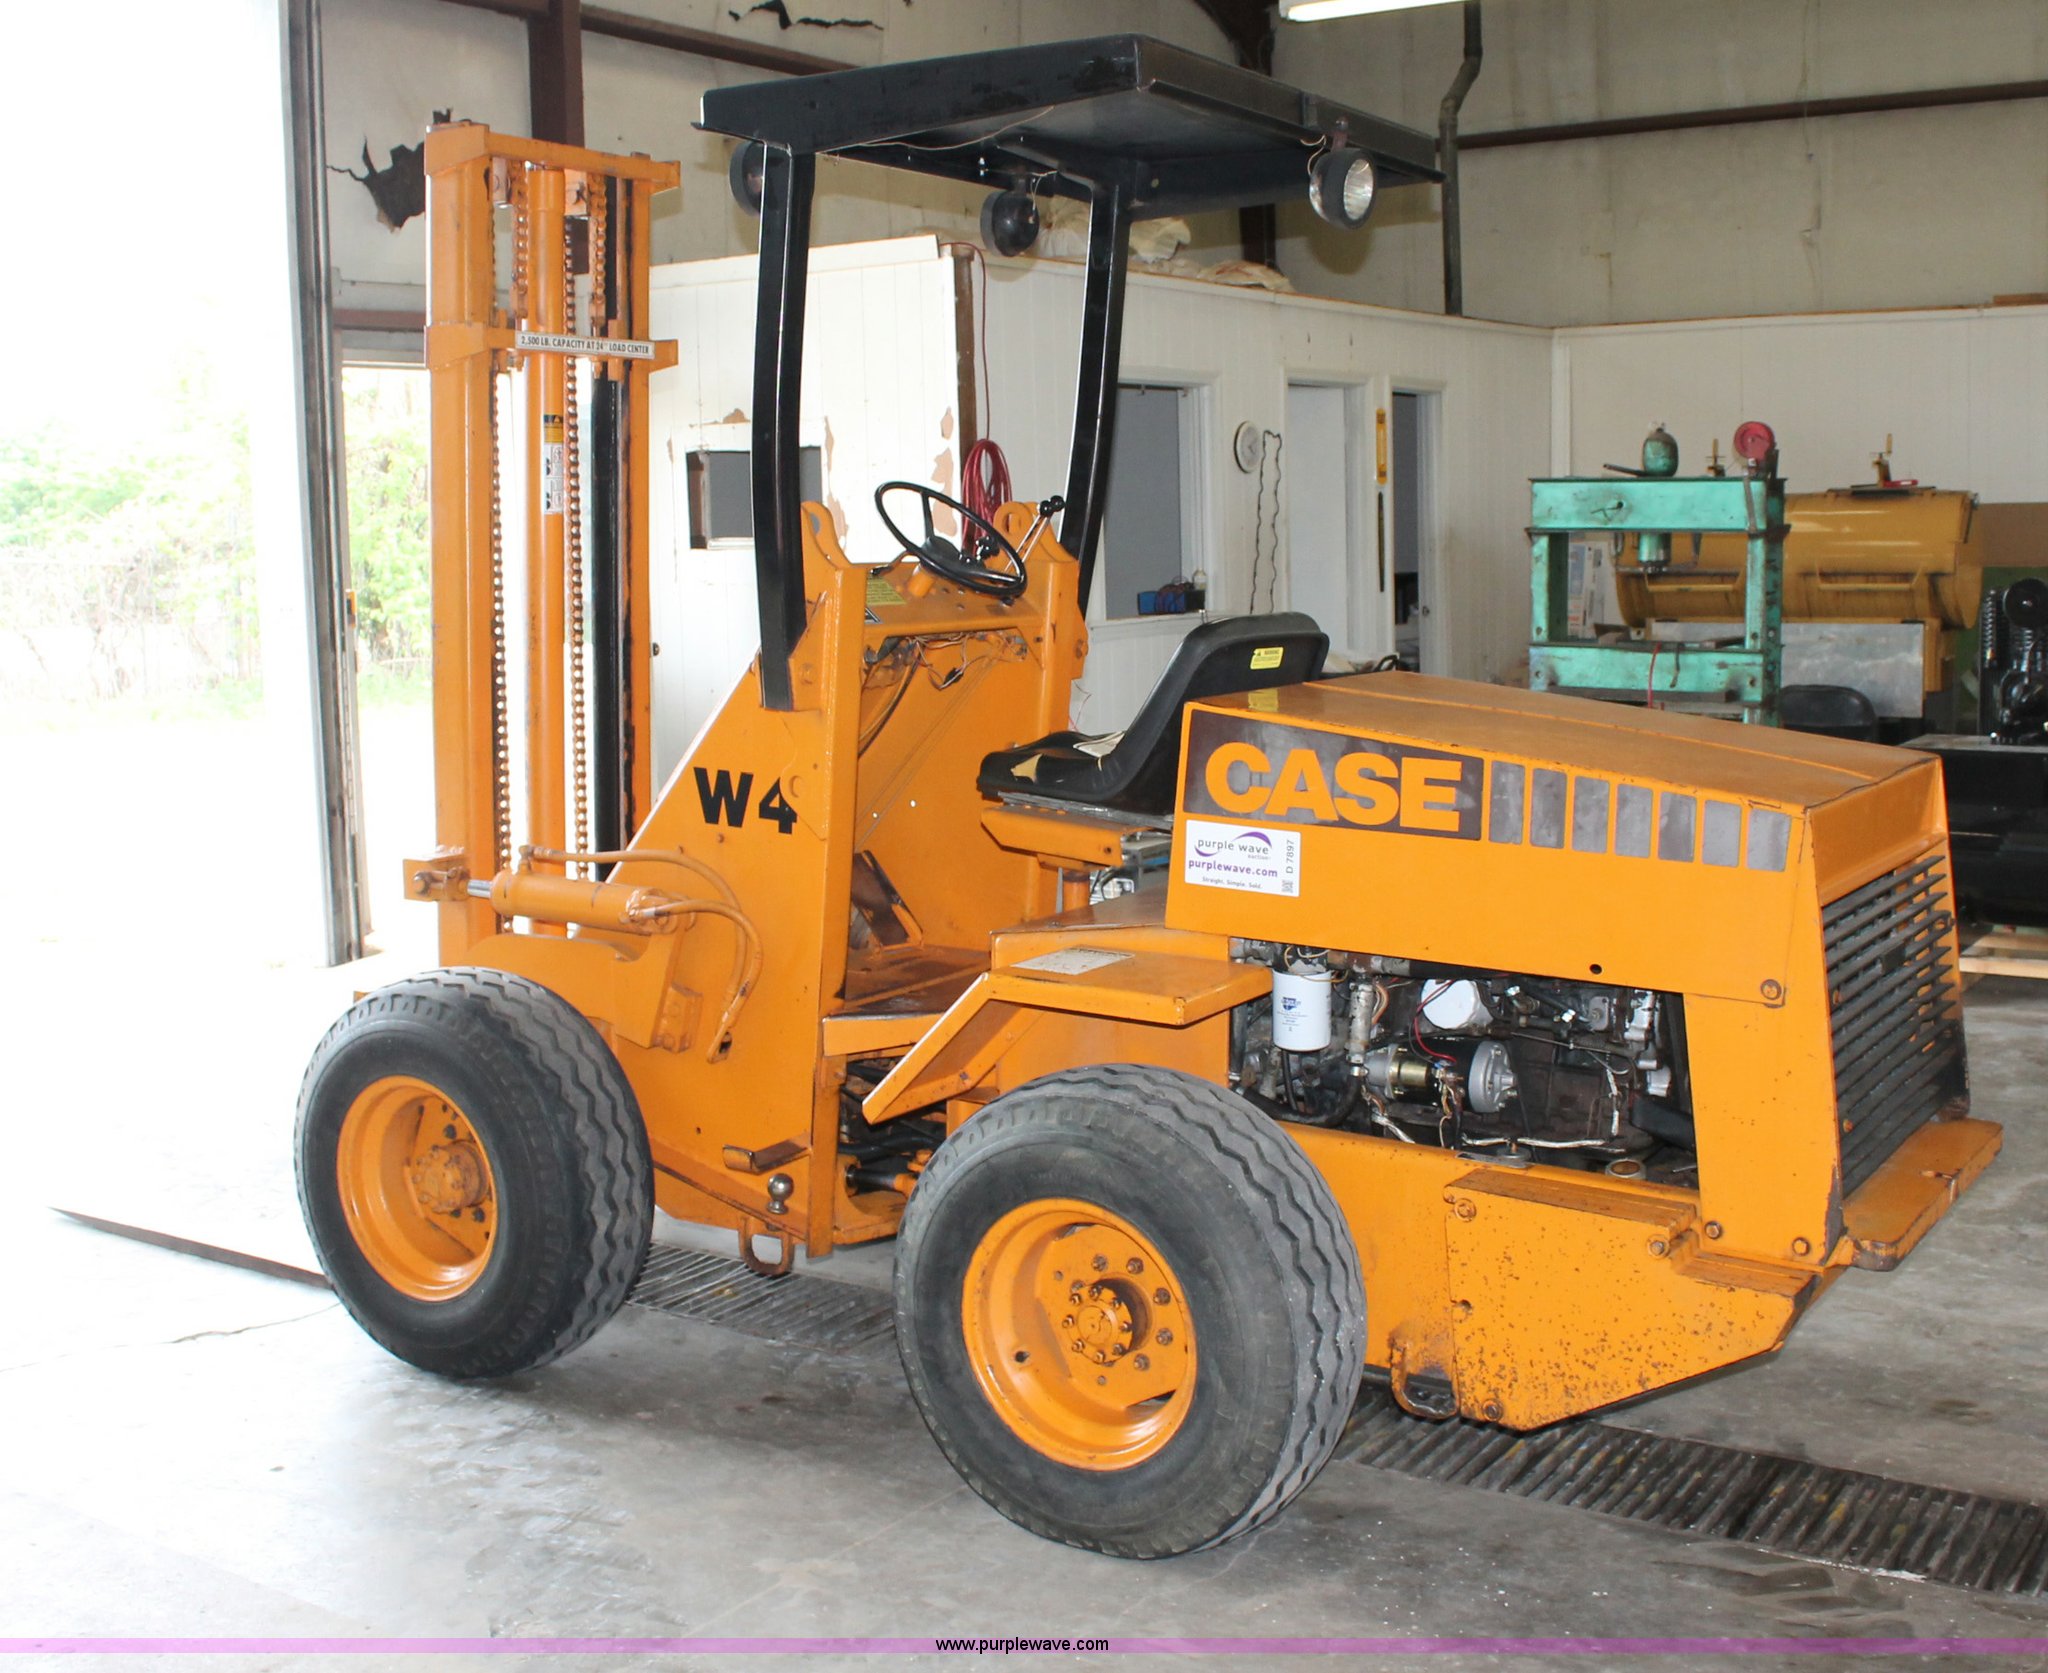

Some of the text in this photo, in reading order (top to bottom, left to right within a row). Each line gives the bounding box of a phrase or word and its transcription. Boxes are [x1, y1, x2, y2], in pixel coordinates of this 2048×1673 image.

[552, 338, 585, 349] CAPACITY
[586, 341, 595, 350] AT
[609, 342, 626, 352] LOAD
[627, 344, 649, 354] CENTER
[1205, 741, 1463, 832] CASE
[693, 766, 797, 835] W4
[1197, 839, 1269, 855] purple wave
[1286, 839, 1295, 874] D 7897
[1188, 859, 1278, 878] purplewave.com
